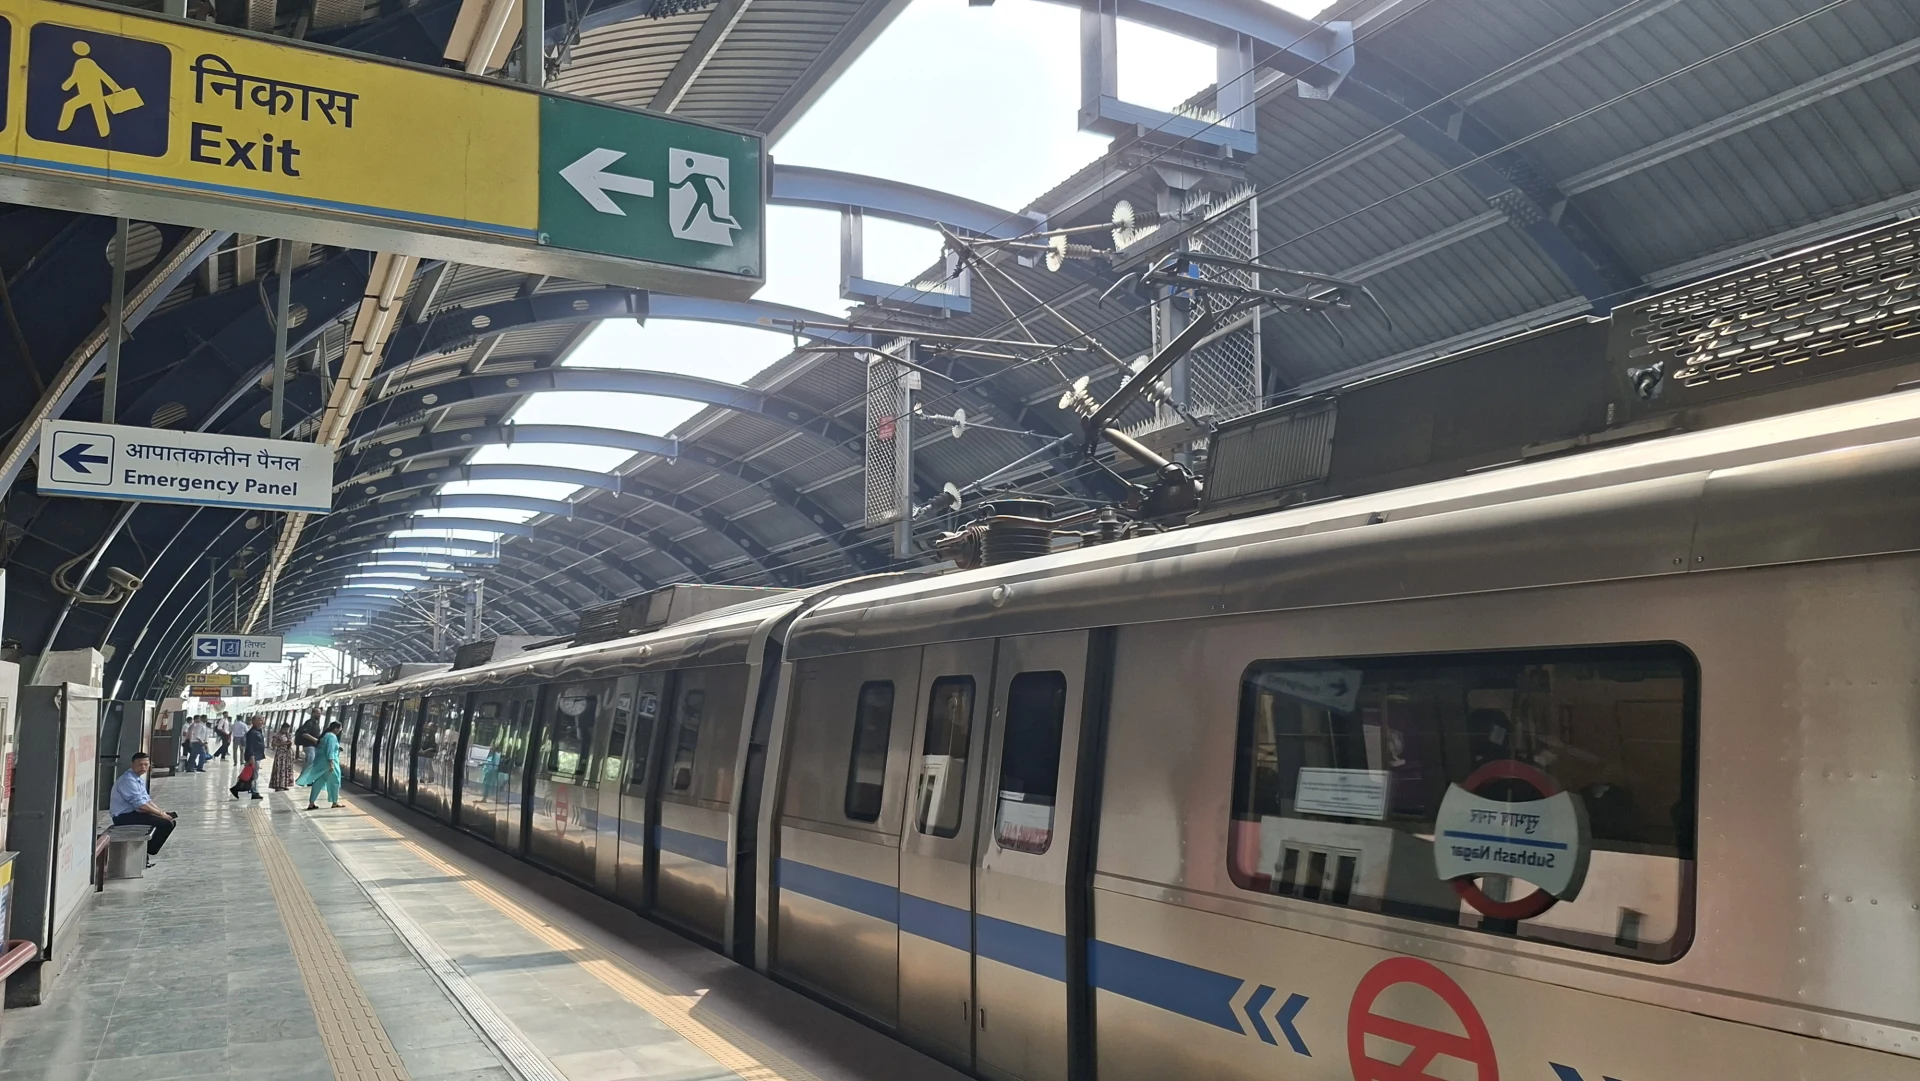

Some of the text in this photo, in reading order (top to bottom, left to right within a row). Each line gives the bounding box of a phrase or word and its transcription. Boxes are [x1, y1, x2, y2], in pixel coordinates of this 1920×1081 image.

[189, 53, 360, 129] निकास
[190, 121, 301, 177] Exit
[125, 443, 302, 472] आपातकालीन पैनल
[124, 469, 298, 496] Emergency Panel
[243, 650, 260, 658] Lift
[244, 639, 266, 649] लिफ्ट
